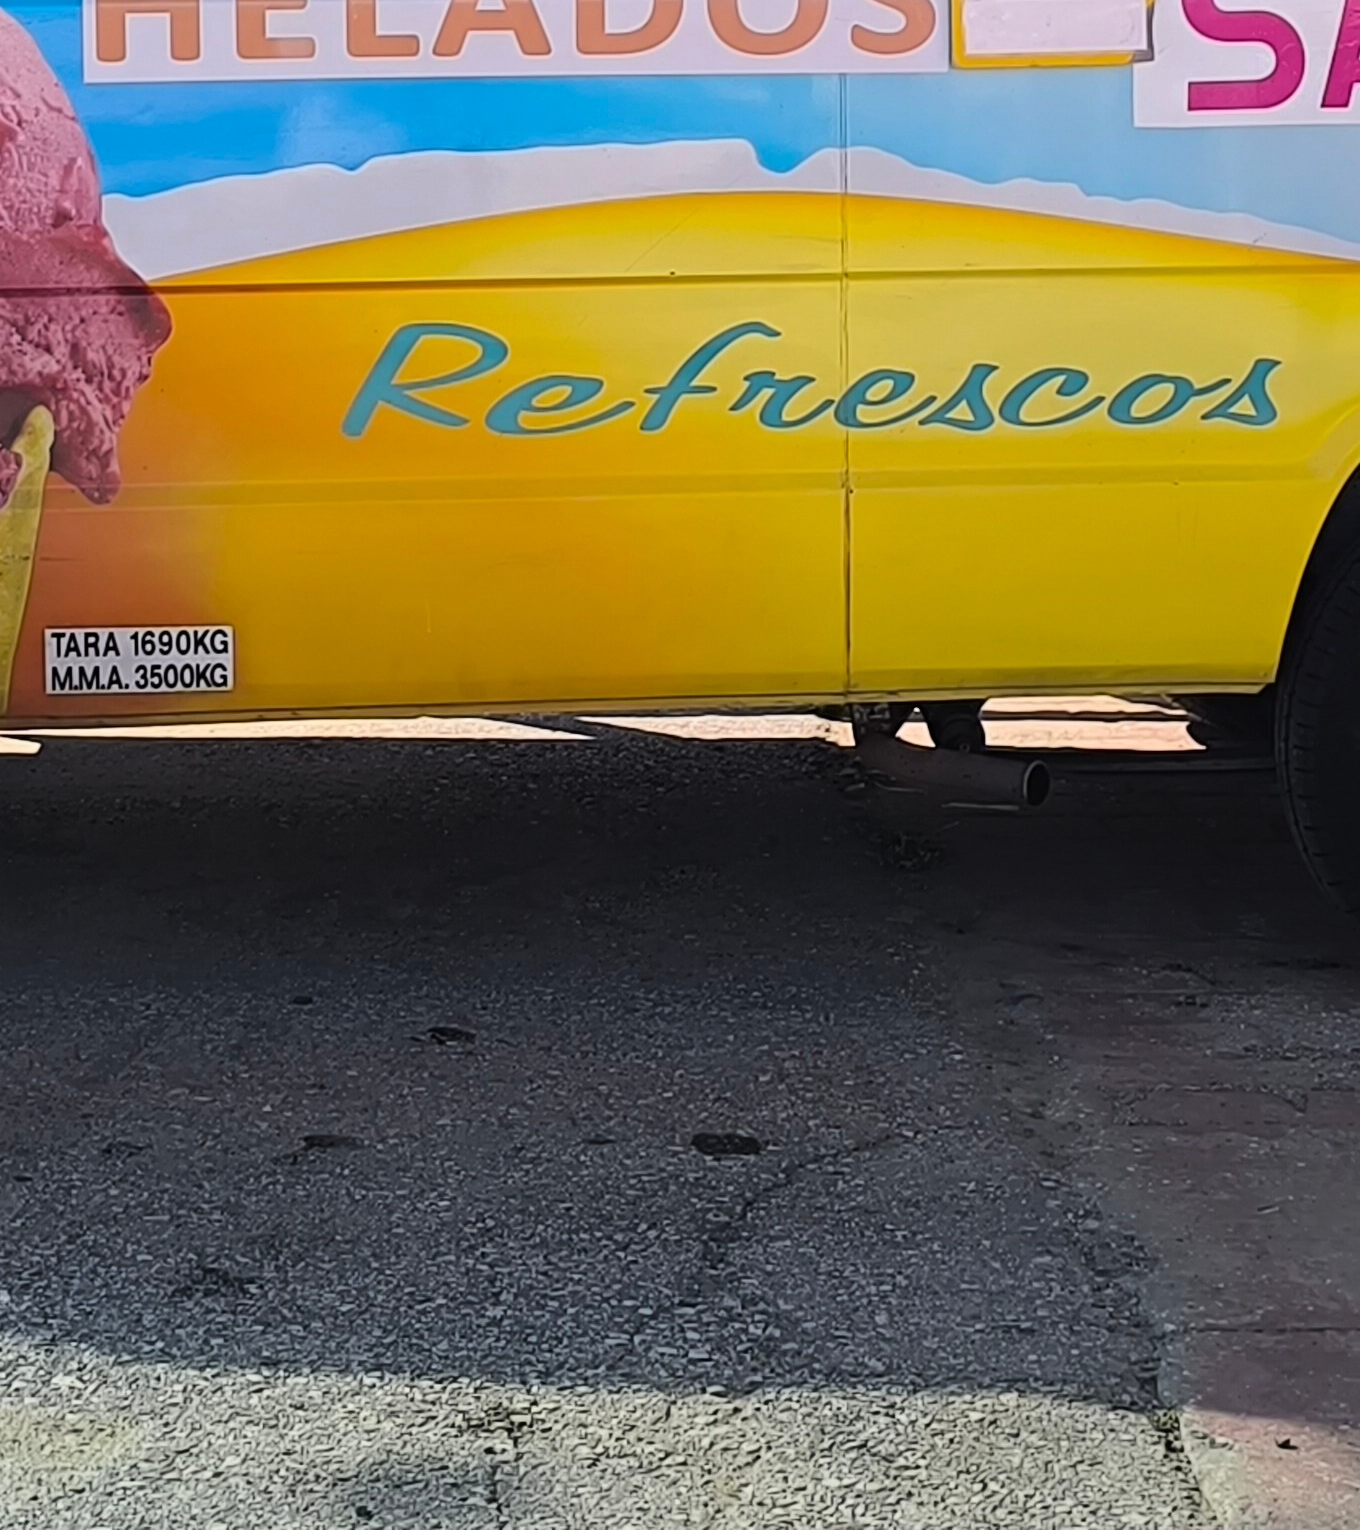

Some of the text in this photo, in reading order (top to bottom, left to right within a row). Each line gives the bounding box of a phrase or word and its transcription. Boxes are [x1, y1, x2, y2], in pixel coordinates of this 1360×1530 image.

[339, 320, 1283, 438] Refrescos
[51, 629, 229, 658] TARA 1690KG
[51, 663, 228, 691] M.M.A. 3500KG
